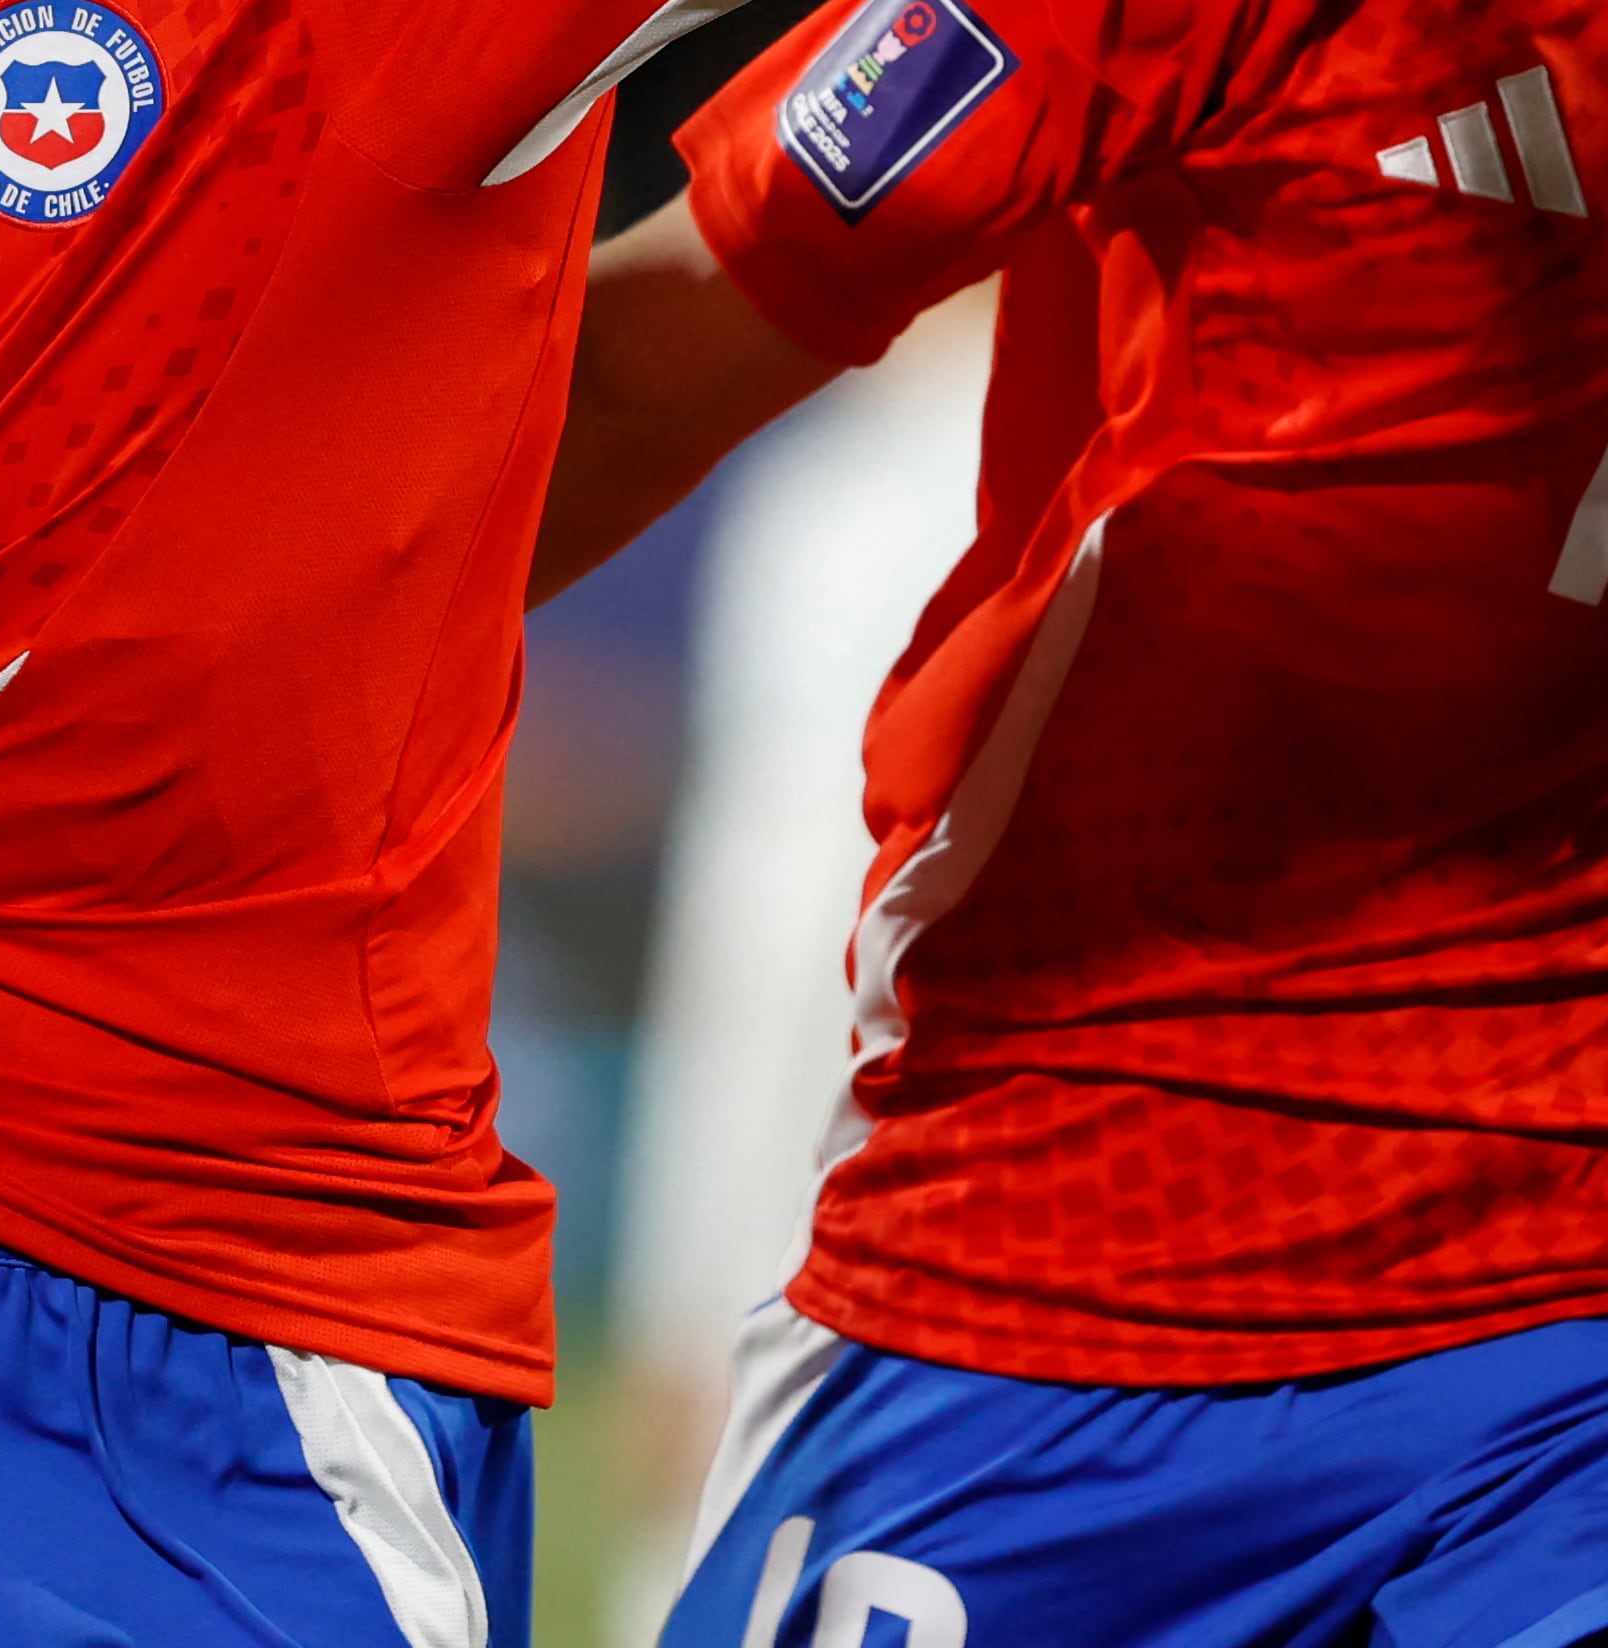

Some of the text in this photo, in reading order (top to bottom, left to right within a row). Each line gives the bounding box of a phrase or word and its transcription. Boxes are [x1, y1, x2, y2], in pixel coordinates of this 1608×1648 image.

[71, 7, 103, 36] DE
[106, 29, 154, 112] FUTBOL
[0, 180, 105, 218] DE CHILE
